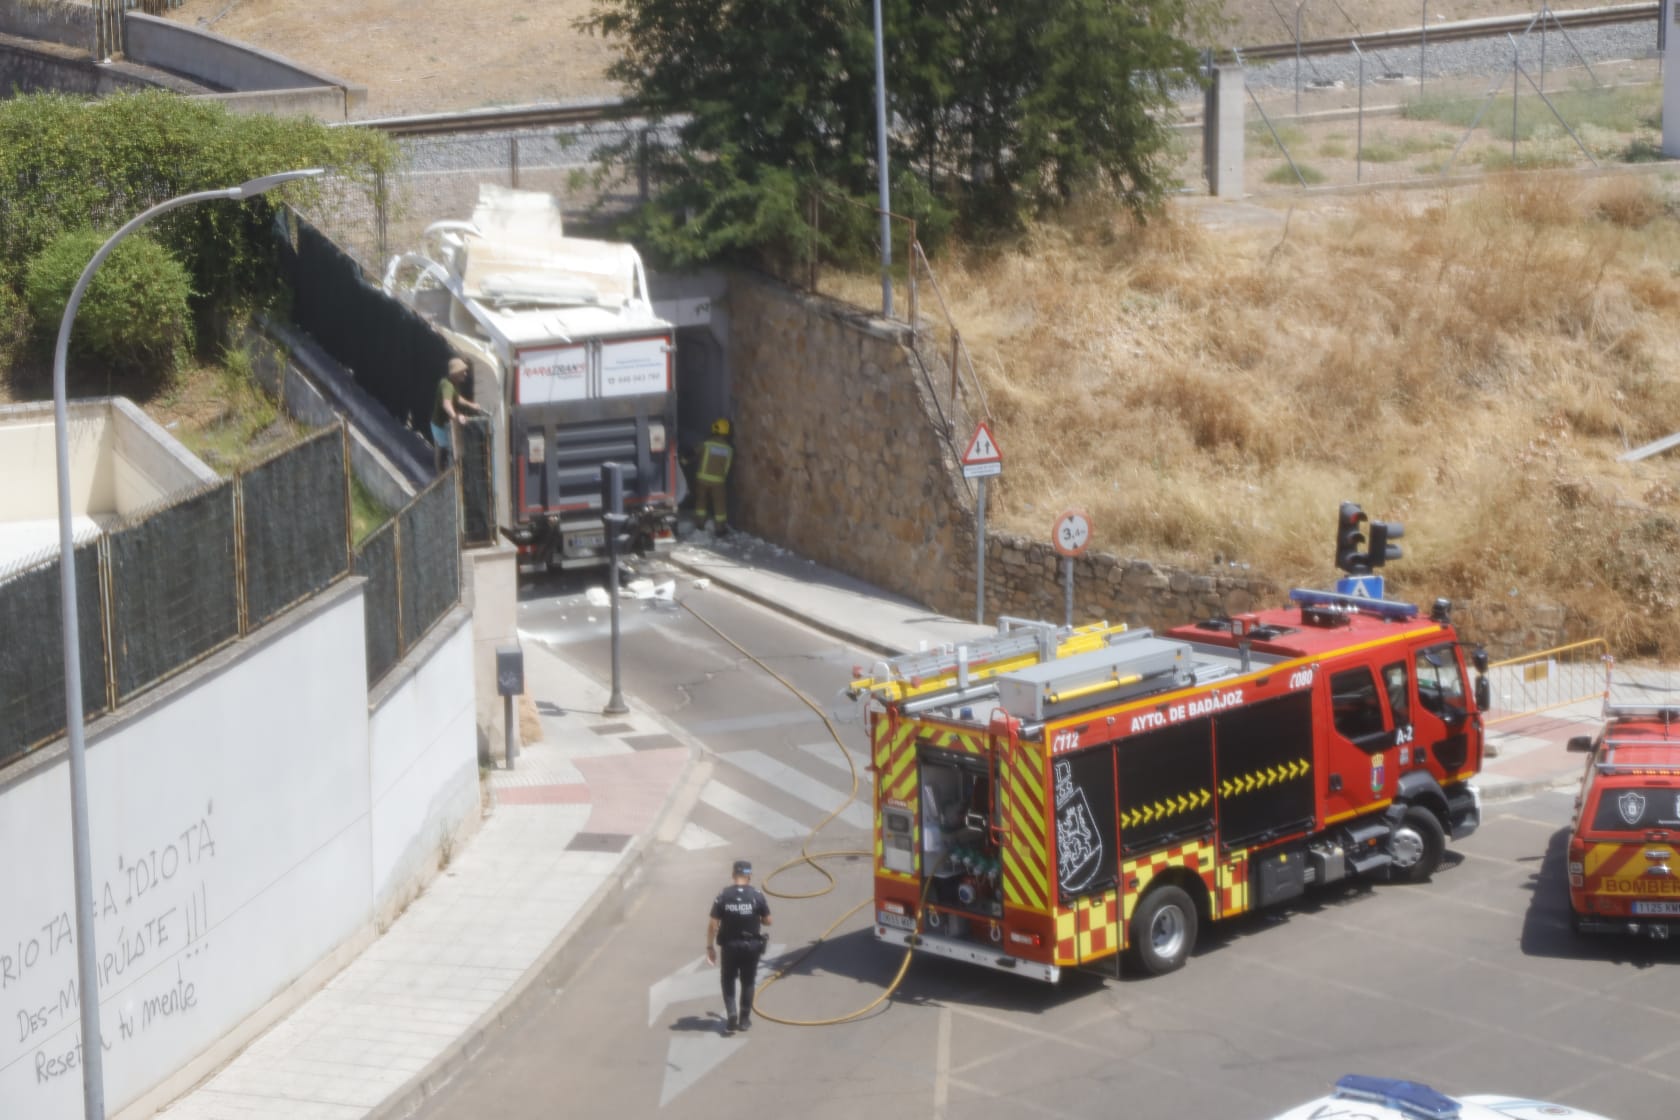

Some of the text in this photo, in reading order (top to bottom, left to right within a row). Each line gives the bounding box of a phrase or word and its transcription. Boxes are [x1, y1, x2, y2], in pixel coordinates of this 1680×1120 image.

[1130, 689, 1243, 732] AYTO. DE BADAJOZ
